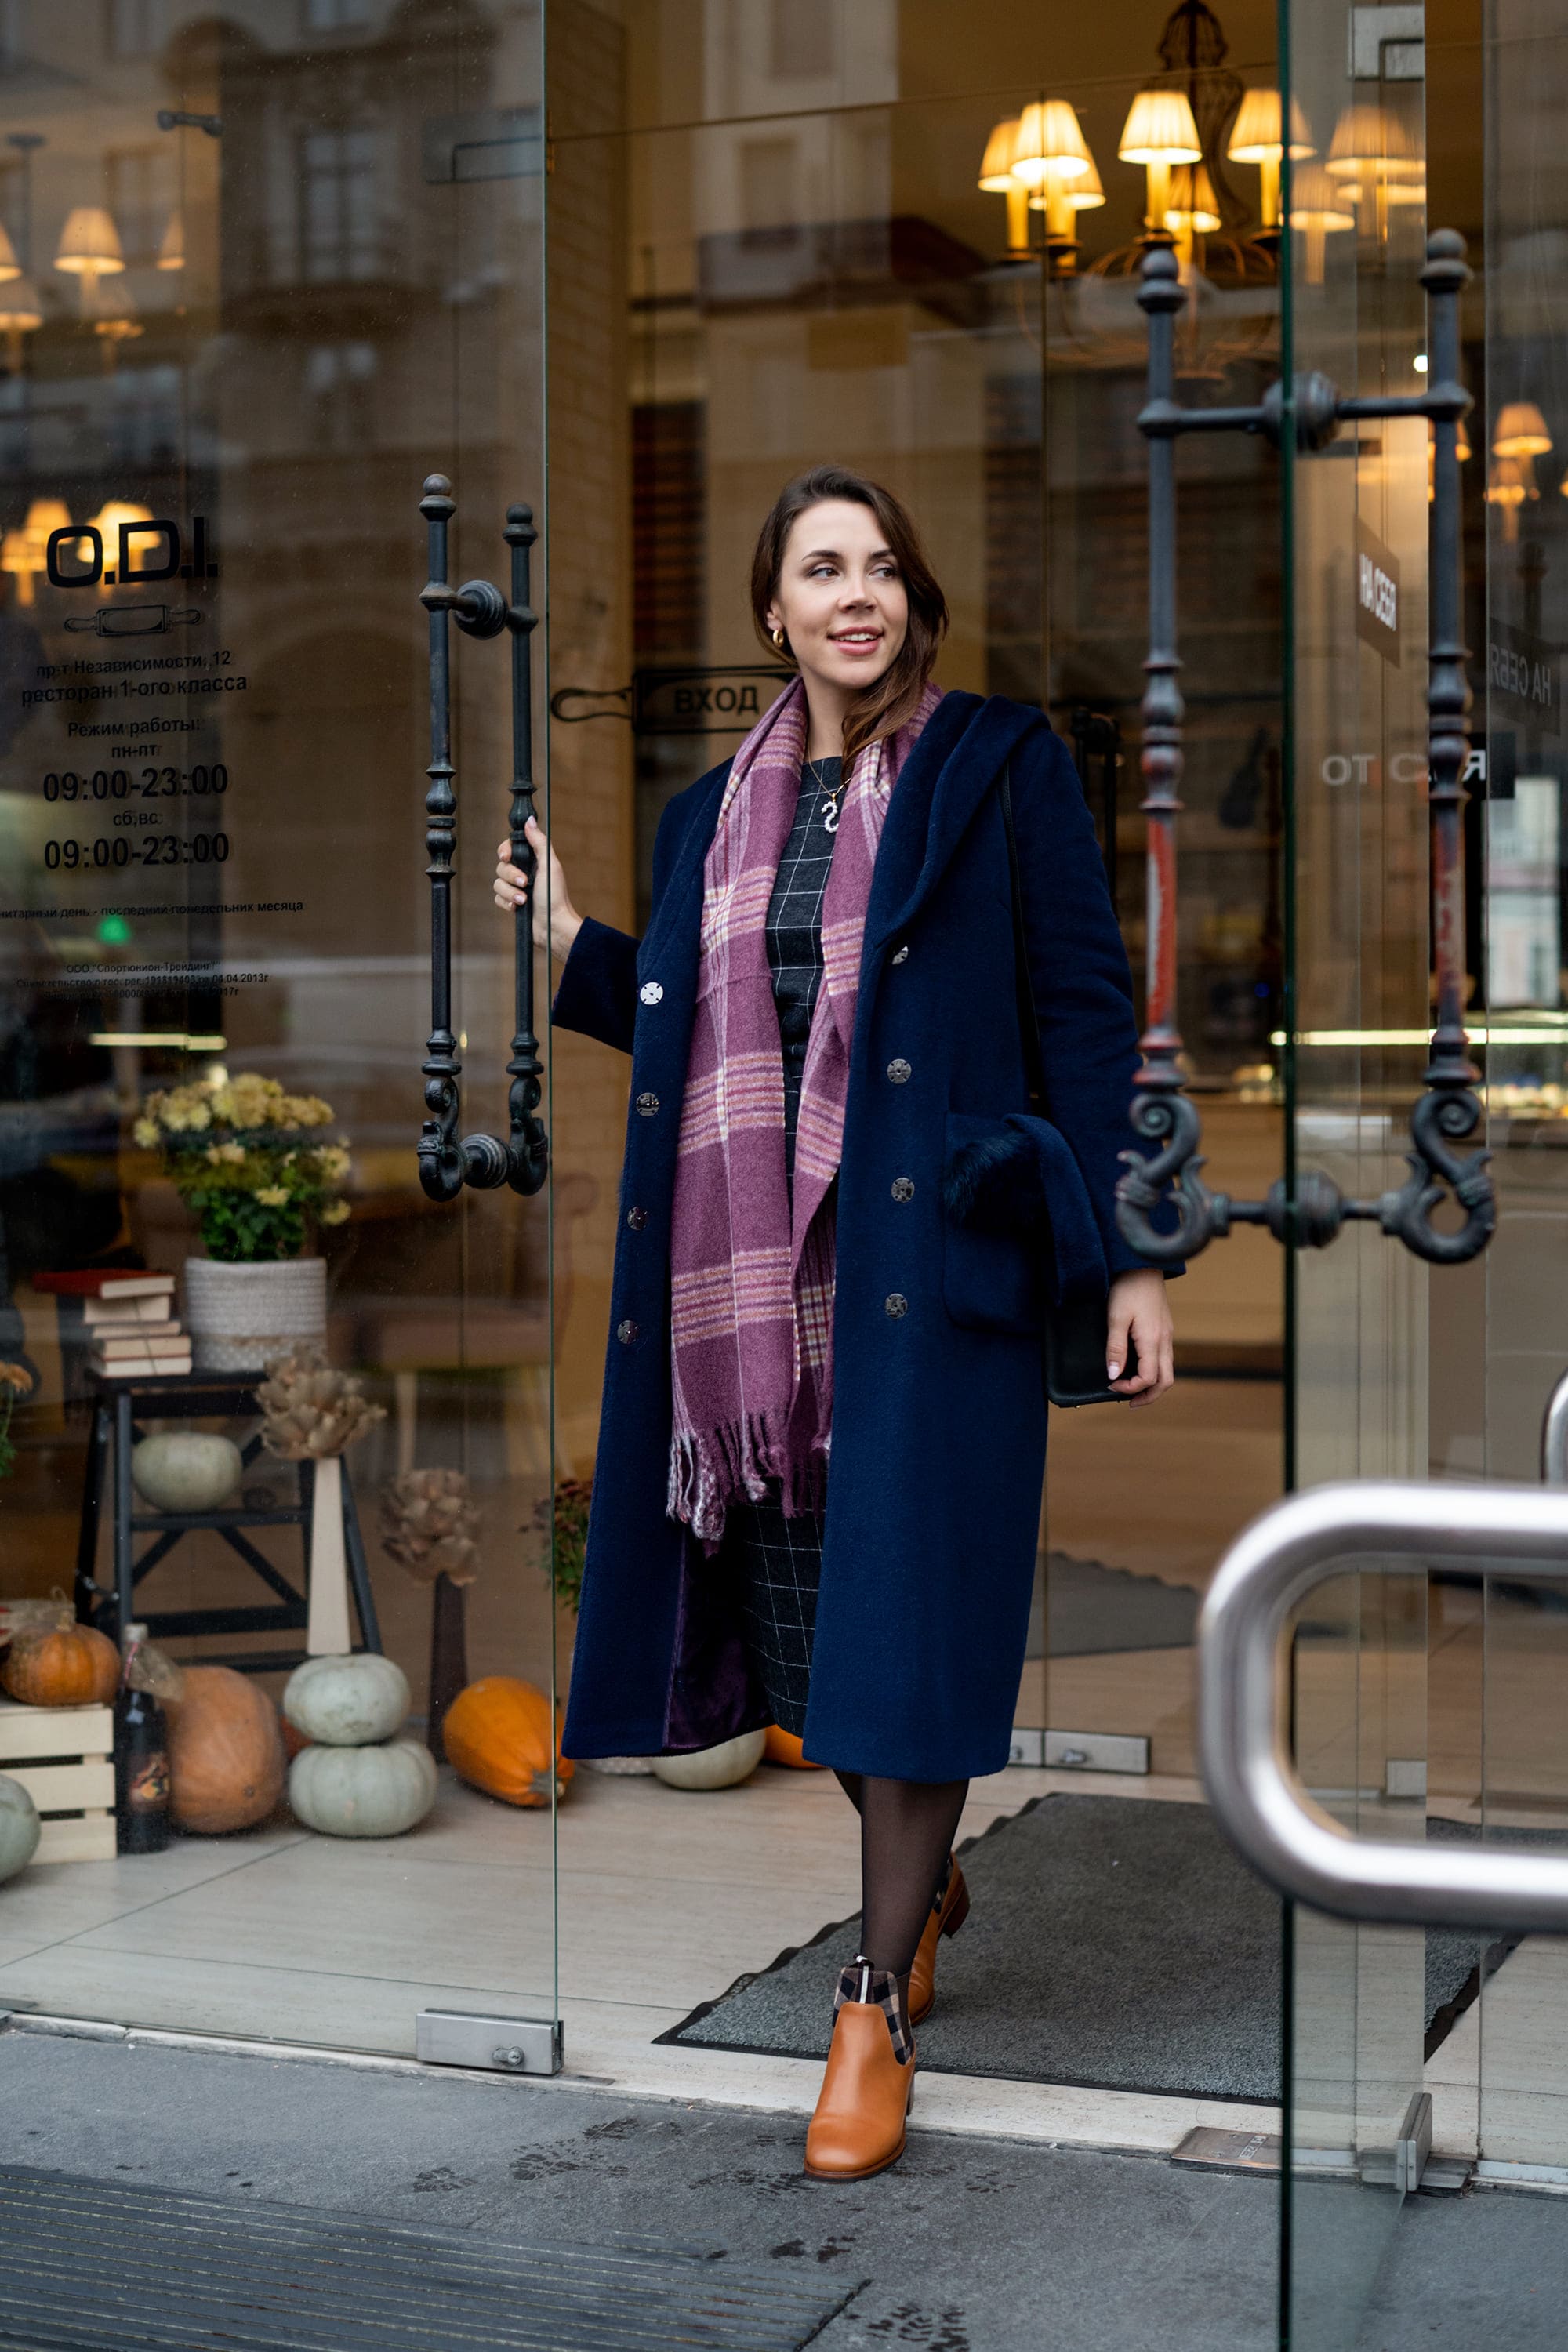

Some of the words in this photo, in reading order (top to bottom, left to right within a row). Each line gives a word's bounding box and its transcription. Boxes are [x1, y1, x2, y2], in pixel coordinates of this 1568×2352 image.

[46, 516, 219, 588] O.D.I.
[36, 664, 70, 679] пр-т
[74, 656, 207, 675] Независимости,
[212, 650, 231, 666] 12
[22, 683, 113, 706] ресторан
[120, 680, 171, 697] 1-ого
[178, 676, 248, 694] класса
[673, 685, 760, 715] ВХОД
[68, 721, 124, 738] Режим
[130, 717, 201, 738] работы:
[111, 744, 158, 758] пн-пт
[1388, 750, 1486, 782] СЯ
[43, 764, 229, 802] 09:00-23:00
[113, 810, 158, 827] сб,вс
[44, 832, 230, 869] 09:00-23:00
[60, 908, 89, 919] день
[257, 901, 303, 913] месяца
